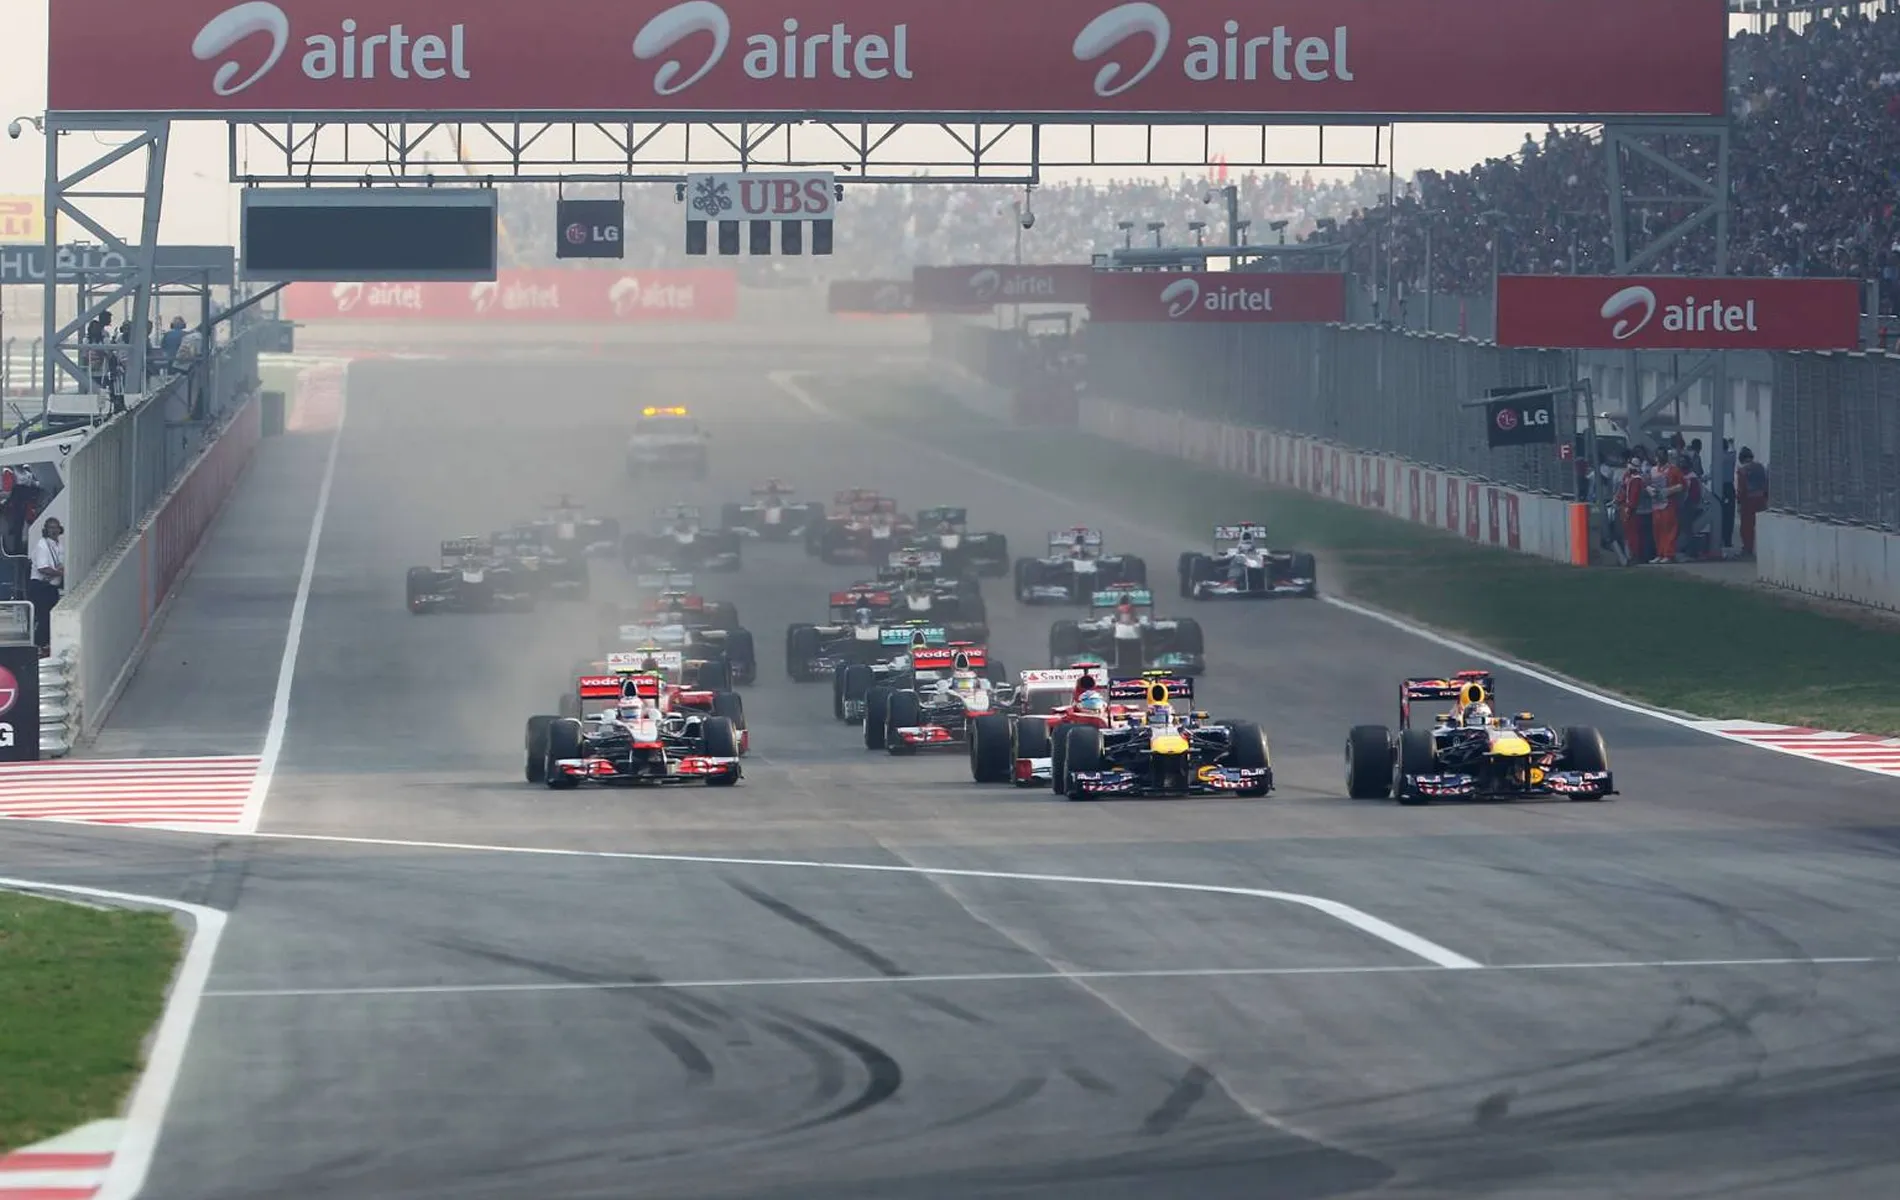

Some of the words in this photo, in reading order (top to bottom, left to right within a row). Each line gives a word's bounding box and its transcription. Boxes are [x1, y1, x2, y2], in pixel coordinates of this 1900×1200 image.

[302, 18, 471, 79] airtel
[743, 18, 913, 79] airtel
[1184, 19, 1354, 81] airtel
[738, 178, 829, 214] UBS
[593, 226, 619, 241] LG
[0, 252, 128, 278] HUBLO
[1003, 275, 1055, 296] airtel
[1204, 285, 1272, 311] airtel
[1663, 296, 1758, 331] airtel
[1523, 409, 1549, 426] LG
[1561, 445, 1570, 459] F
[0, 722, 14, 747] G
